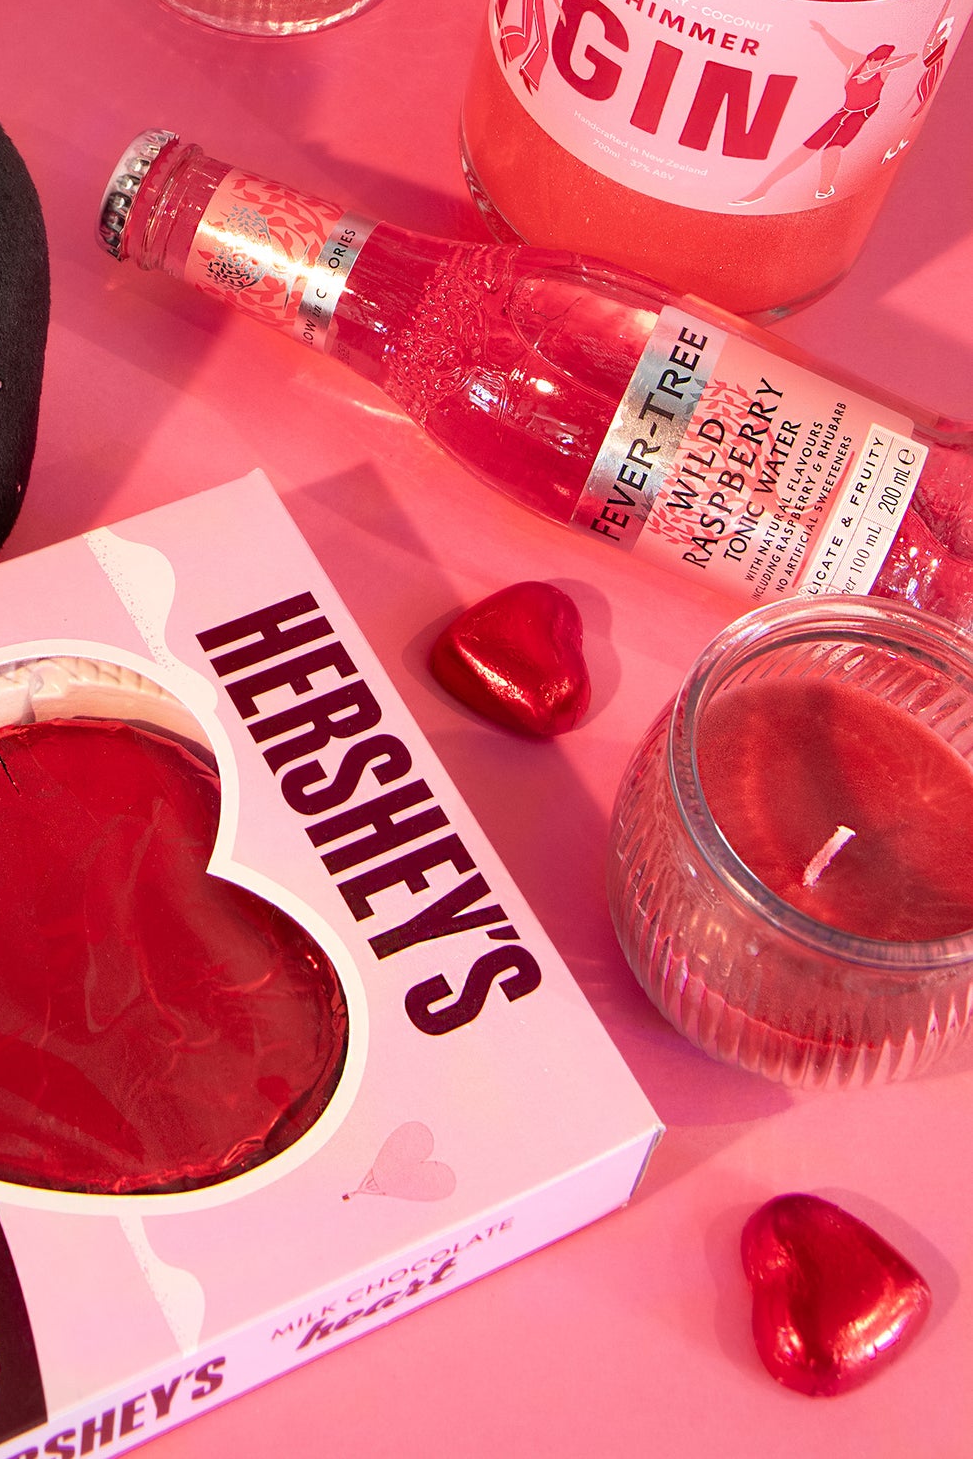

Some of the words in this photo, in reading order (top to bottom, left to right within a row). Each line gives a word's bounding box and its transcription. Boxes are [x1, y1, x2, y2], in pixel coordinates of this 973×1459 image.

[701, 6, 774, 33] COCONUT
[574, 110, 628, 148] Handcrafted
[630, 145, 639, 154] in
[641, 149, 665, 164] New
[666, 158, 709, 177] Zealand
[652, 168, 676, 181] ABV
[316, 229, 356, 299] CORIES
[590, 326, 708, 541] FEVER-TREE
[666, 418, 726, 511] WILD
[682, 377, 784, 569] RASPBERRY
[723, 500, 765, 562] TONIC
[754, 420, 802, 496] WATER
[745, 554, 762, 582] WITH
[760, 496, 792, 557] NATURAL
[787, 422, 823, 491] FLAVOURS
[752, 554, 781, 601] INCLUDING
[776, 476, 816, 557] RASPBERRY
[813, 464, 822, 473] &
[818, 402, 846, 459] RHUBARB
[776, 578, 788, 592] NO
[785, 517, 818, 582] ARTIFICIAL
[815, 435, 852, 512] SWEETENERS
[841, 517, 853, 527] &
[850, 437, 884, 506] FRUITY
[878, 487, 902, 515] 200
[850, 549, 870, 574] 100
[195, 590, 542, 1036] HERSHEY'S
[270, 1300, 339, 1341] MILK
[346, 1216, 515, 1303] CHOCOLATE
[296, 1257, 457, 1351] heart
